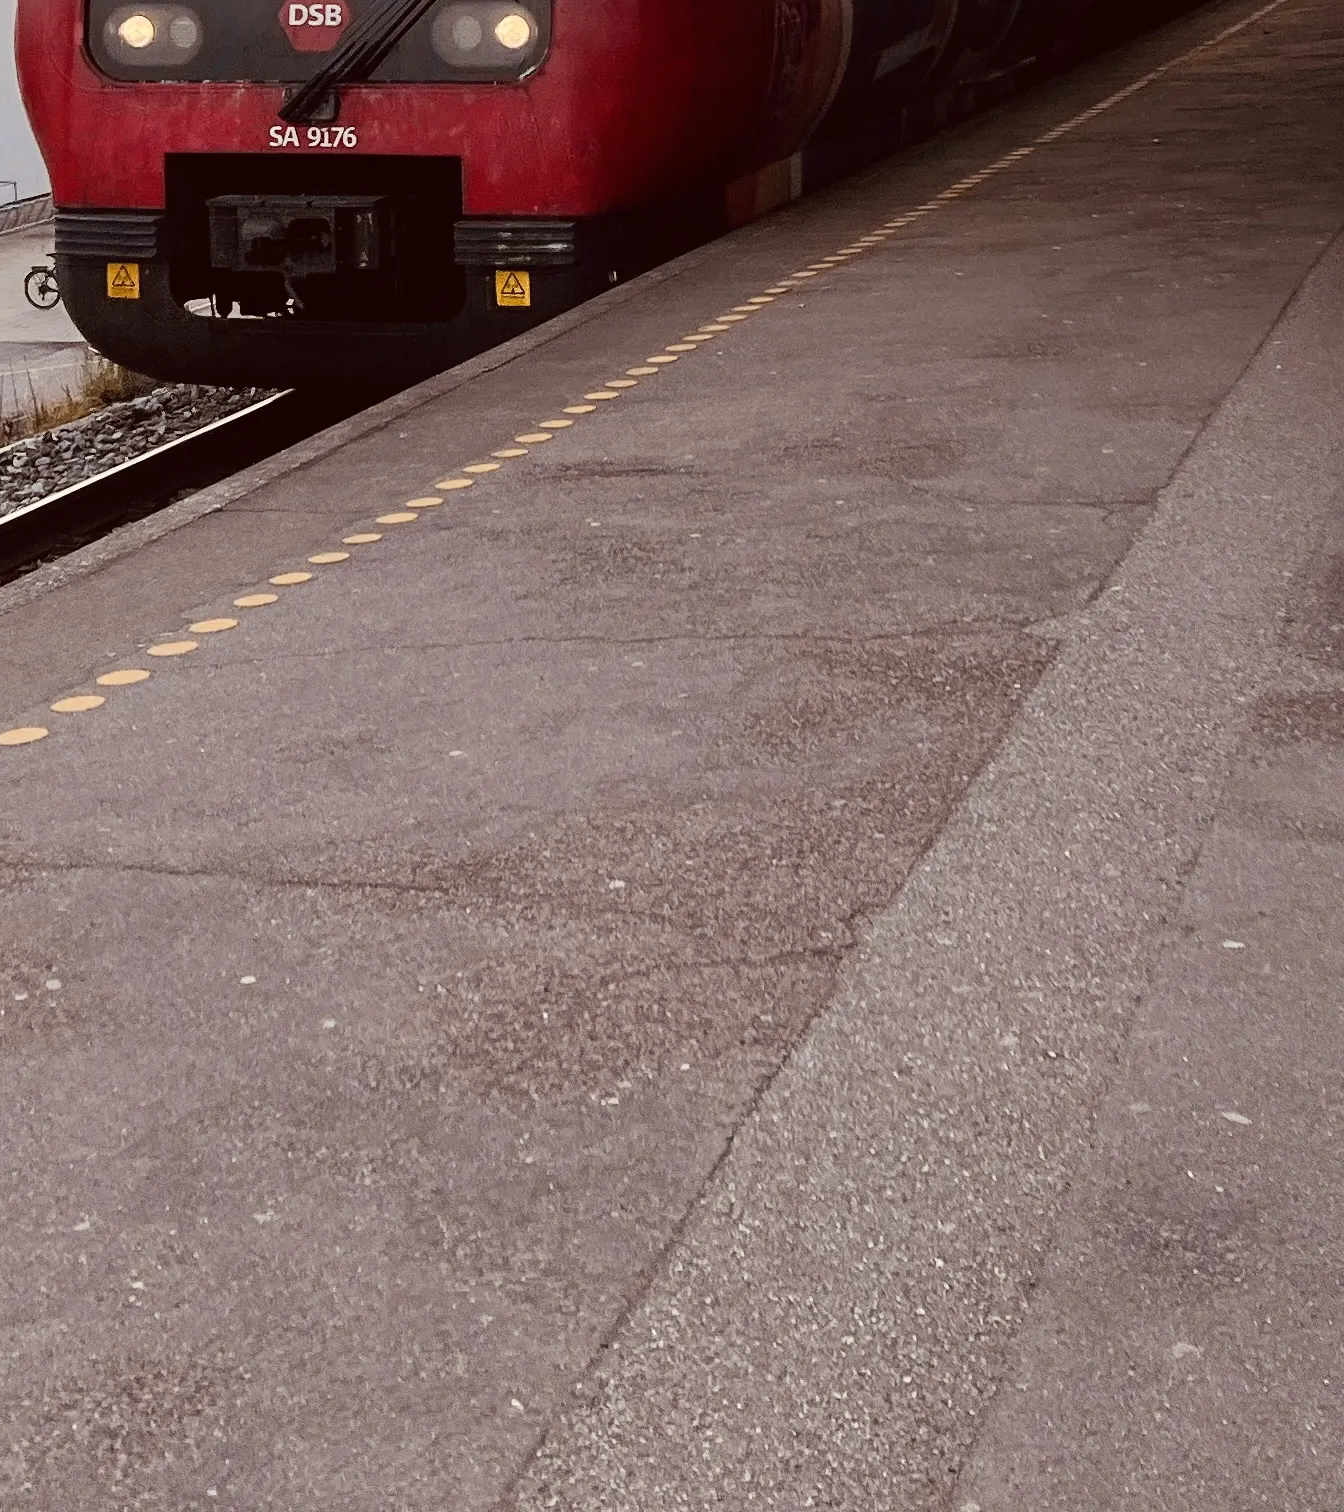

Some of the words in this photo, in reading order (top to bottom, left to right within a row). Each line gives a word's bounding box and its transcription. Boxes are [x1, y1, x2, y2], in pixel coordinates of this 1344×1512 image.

[288, 3, 342, 27] DSB
[269, 125, 300, 148] SA
[307, 126, 358, 148] 9176
